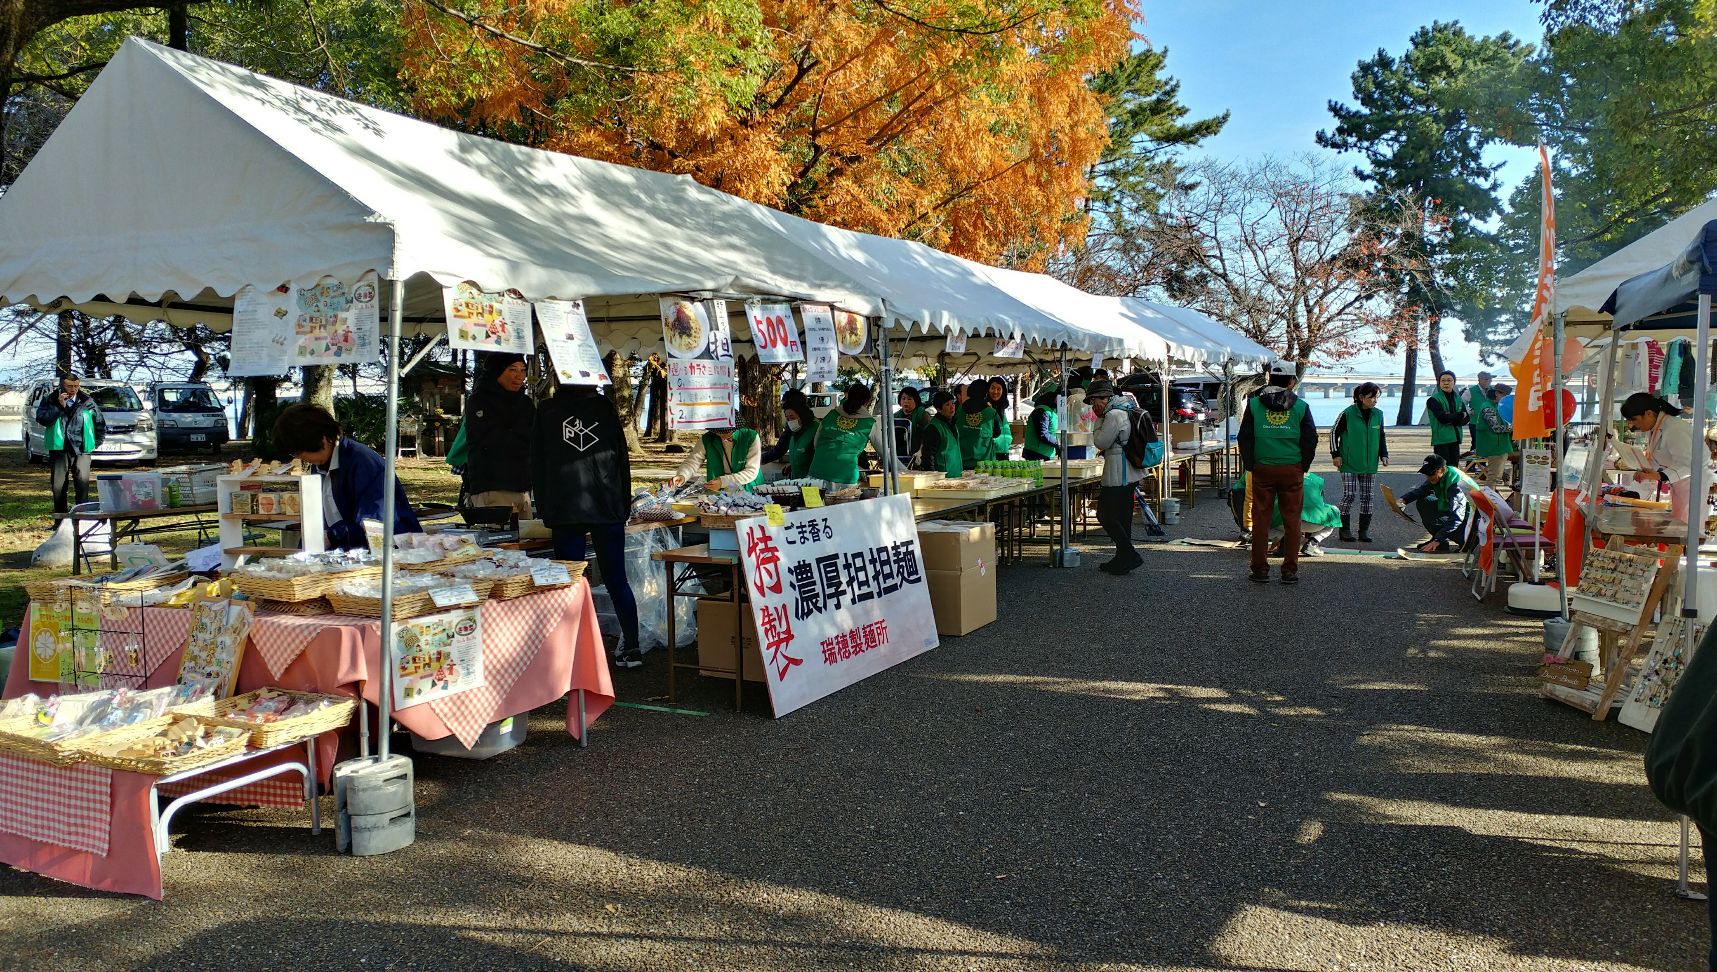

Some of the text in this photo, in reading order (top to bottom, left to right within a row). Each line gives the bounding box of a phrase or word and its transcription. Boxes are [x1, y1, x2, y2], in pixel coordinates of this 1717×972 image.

[784, 517, 833, 545] ごま香る
[746, 524, 803, 682] 特製
[787, 539, 922, 622] 濃厚担担麺
[820, 618, 889, 666] 瑞穂製麺所
